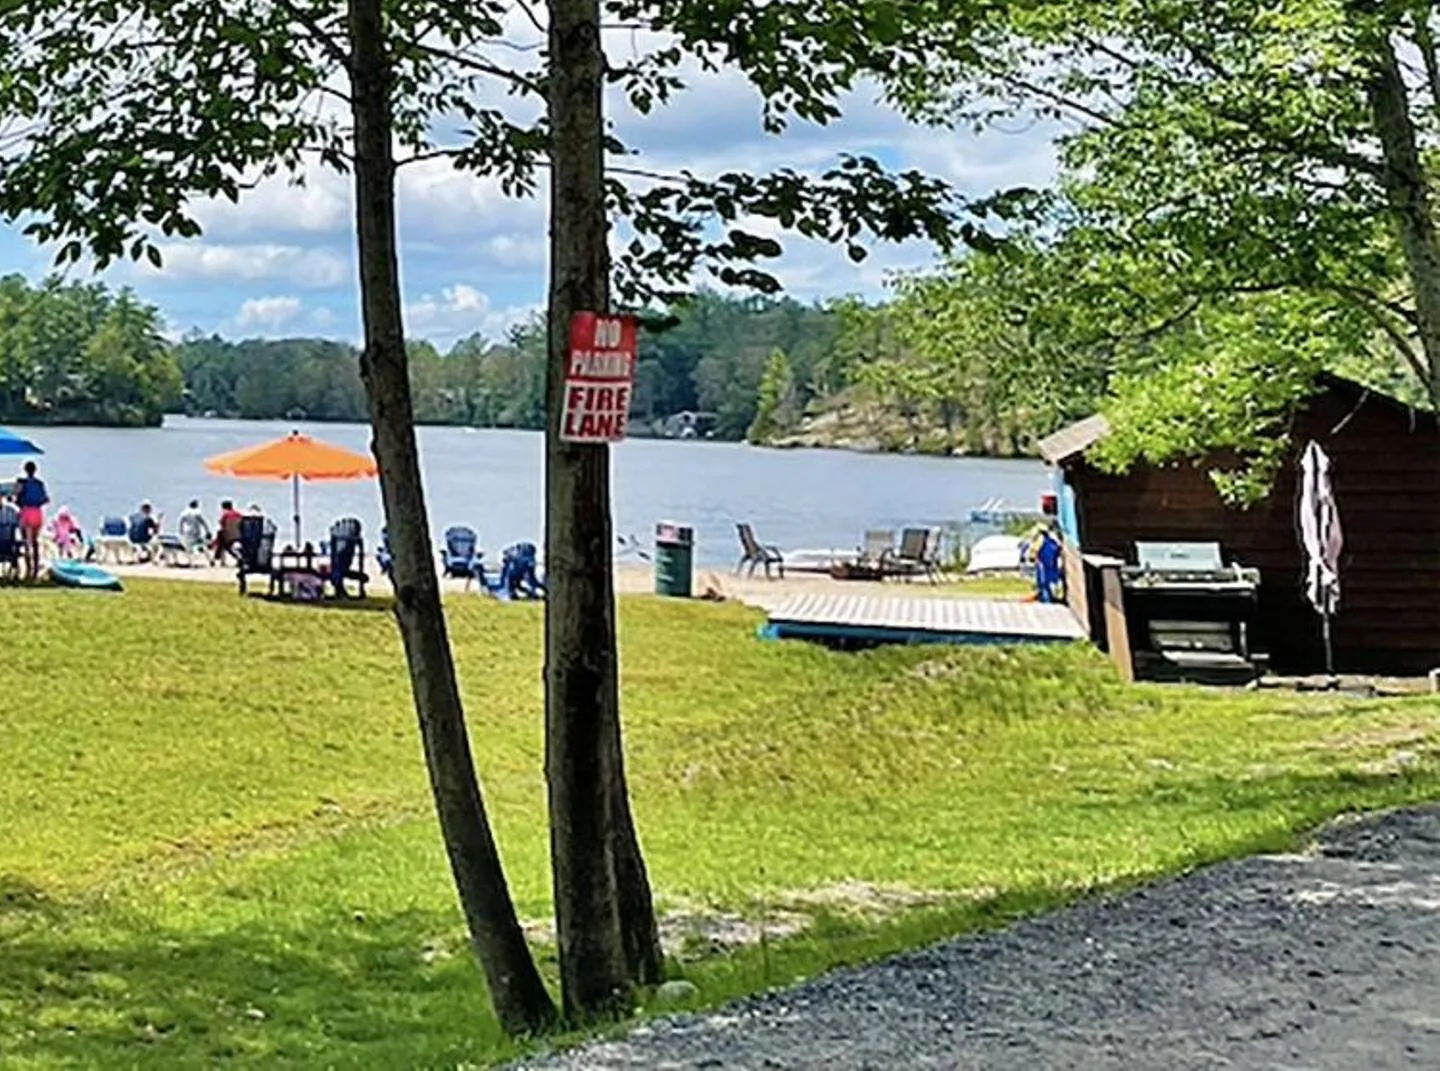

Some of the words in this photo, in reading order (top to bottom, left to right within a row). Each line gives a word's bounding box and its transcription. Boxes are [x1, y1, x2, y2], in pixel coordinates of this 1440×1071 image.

[594, 318, 622, 348] NO
[567, 387, 629, 411] FIRE
[563, 413, 627, 437] LANE
